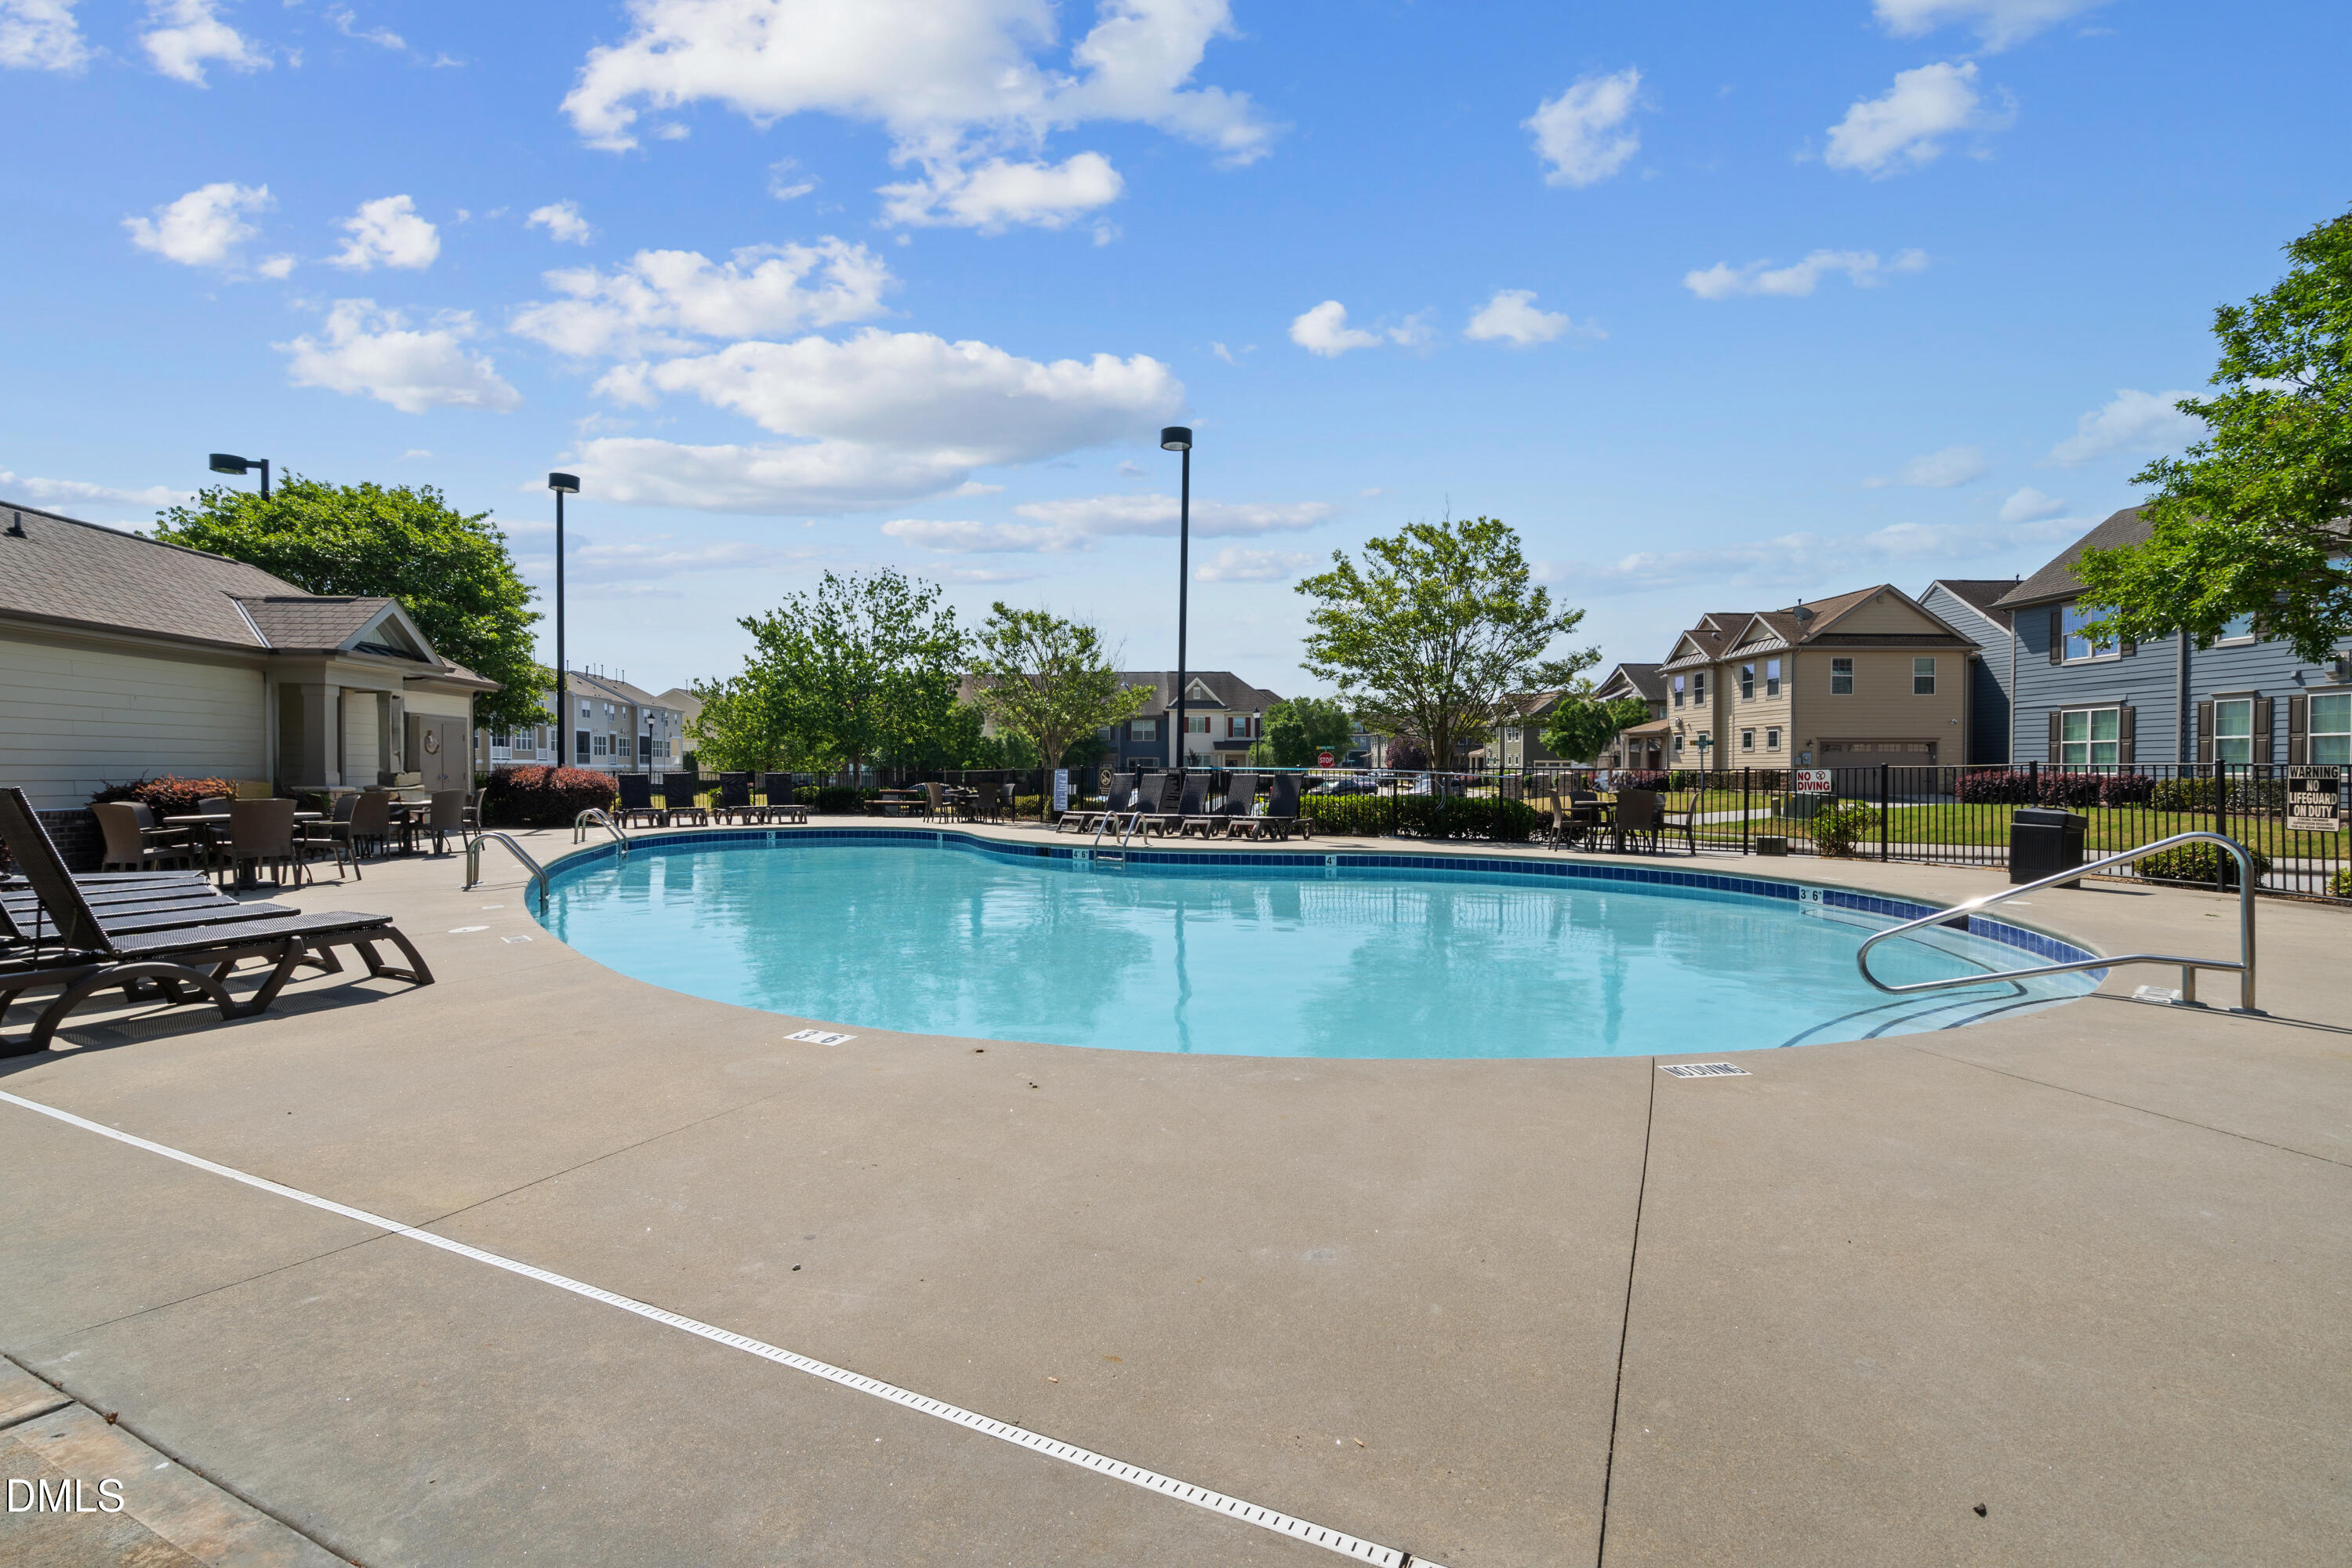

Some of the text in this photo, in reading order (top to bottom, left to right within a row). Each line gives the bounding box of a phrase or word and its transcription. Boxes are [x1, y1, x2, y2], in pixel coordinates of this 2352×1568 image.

[1797, 771, 1811, 781] NO
[2289, 766, 2339, 779] WARNING
[1797, 781, 1831, 791] DIVING
[2306, 779, 2320, 792] NO
[2289, 792, 2338, 805] LIFEGUARD
[2293, 804, 2333, 818] ON DUTY
[793, 1030, 845, 1044] 3 6
[1662, 1063, 1748, 1077] NO DIVING
